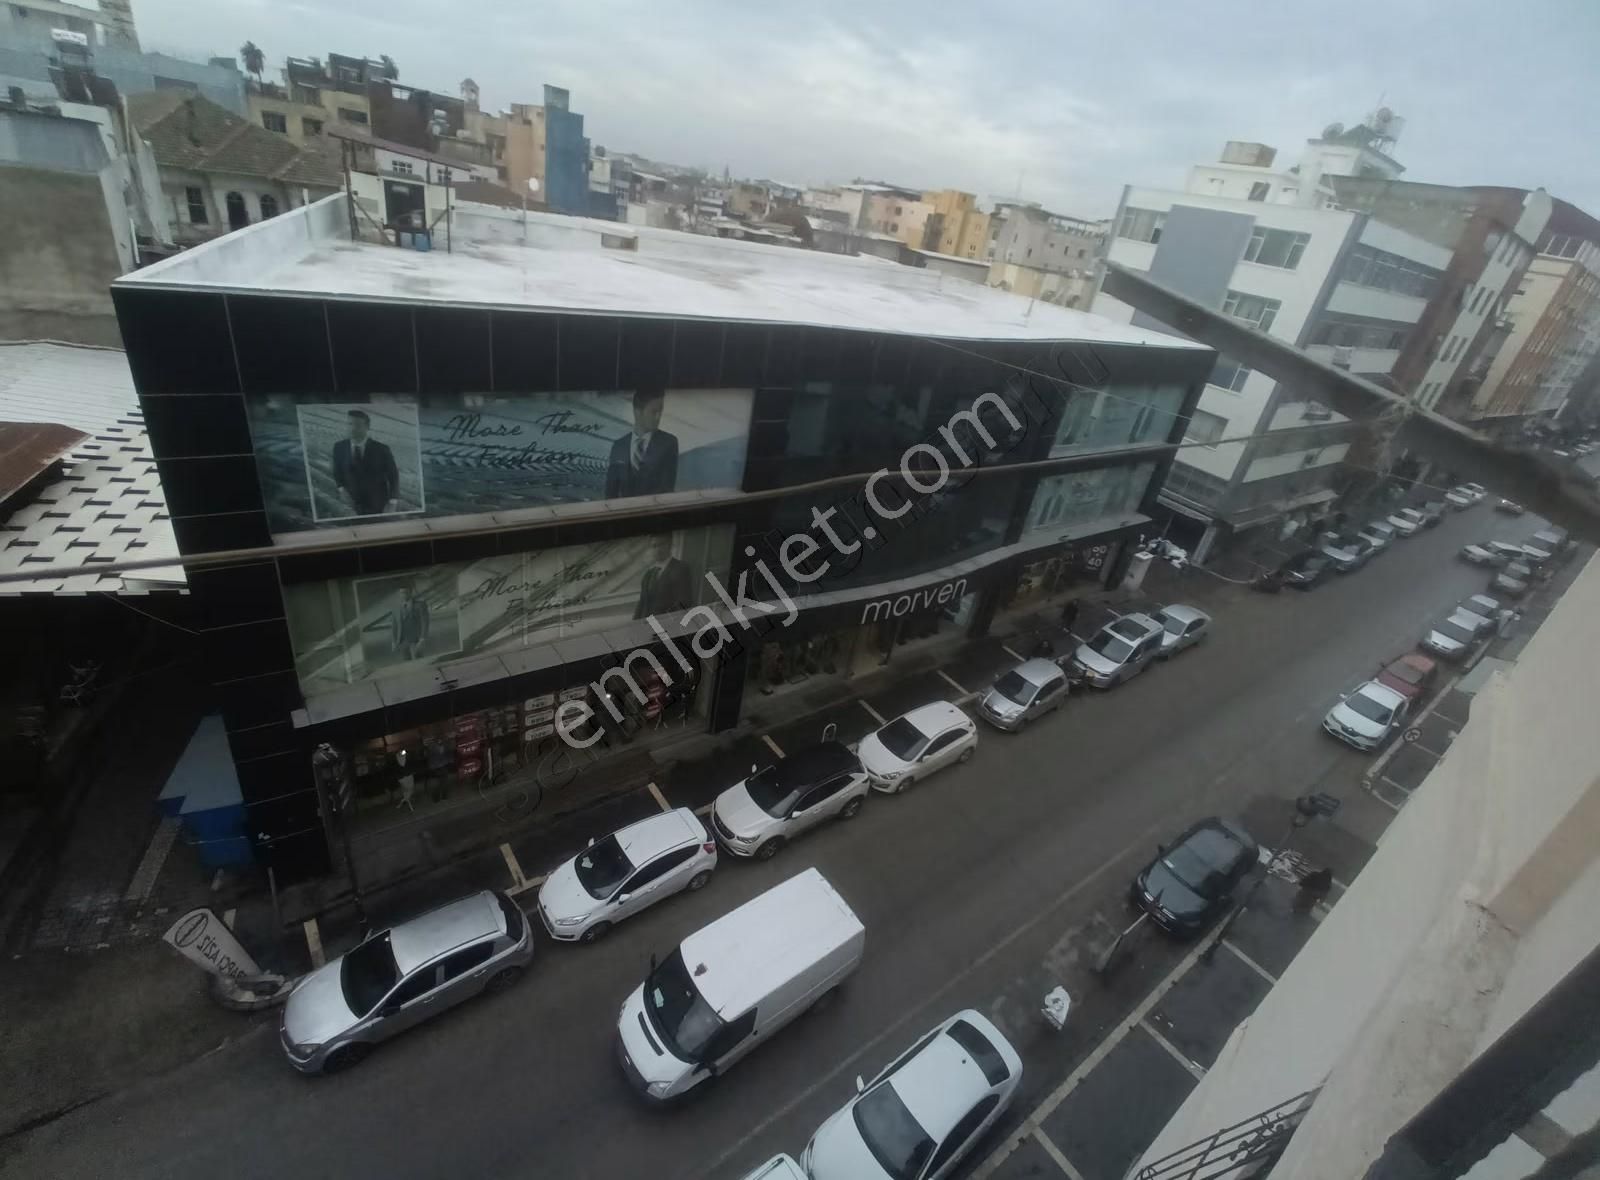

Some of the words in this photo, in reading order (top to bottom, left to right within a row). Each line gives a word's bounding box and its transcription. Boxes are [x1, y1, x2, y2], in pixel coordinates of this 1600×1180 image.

[443, 413, 523, 440] More
[536, 410, 604, 435] Than
[477, 441, 574, 468] Fashion
[861, 579, 967, 625] morven
